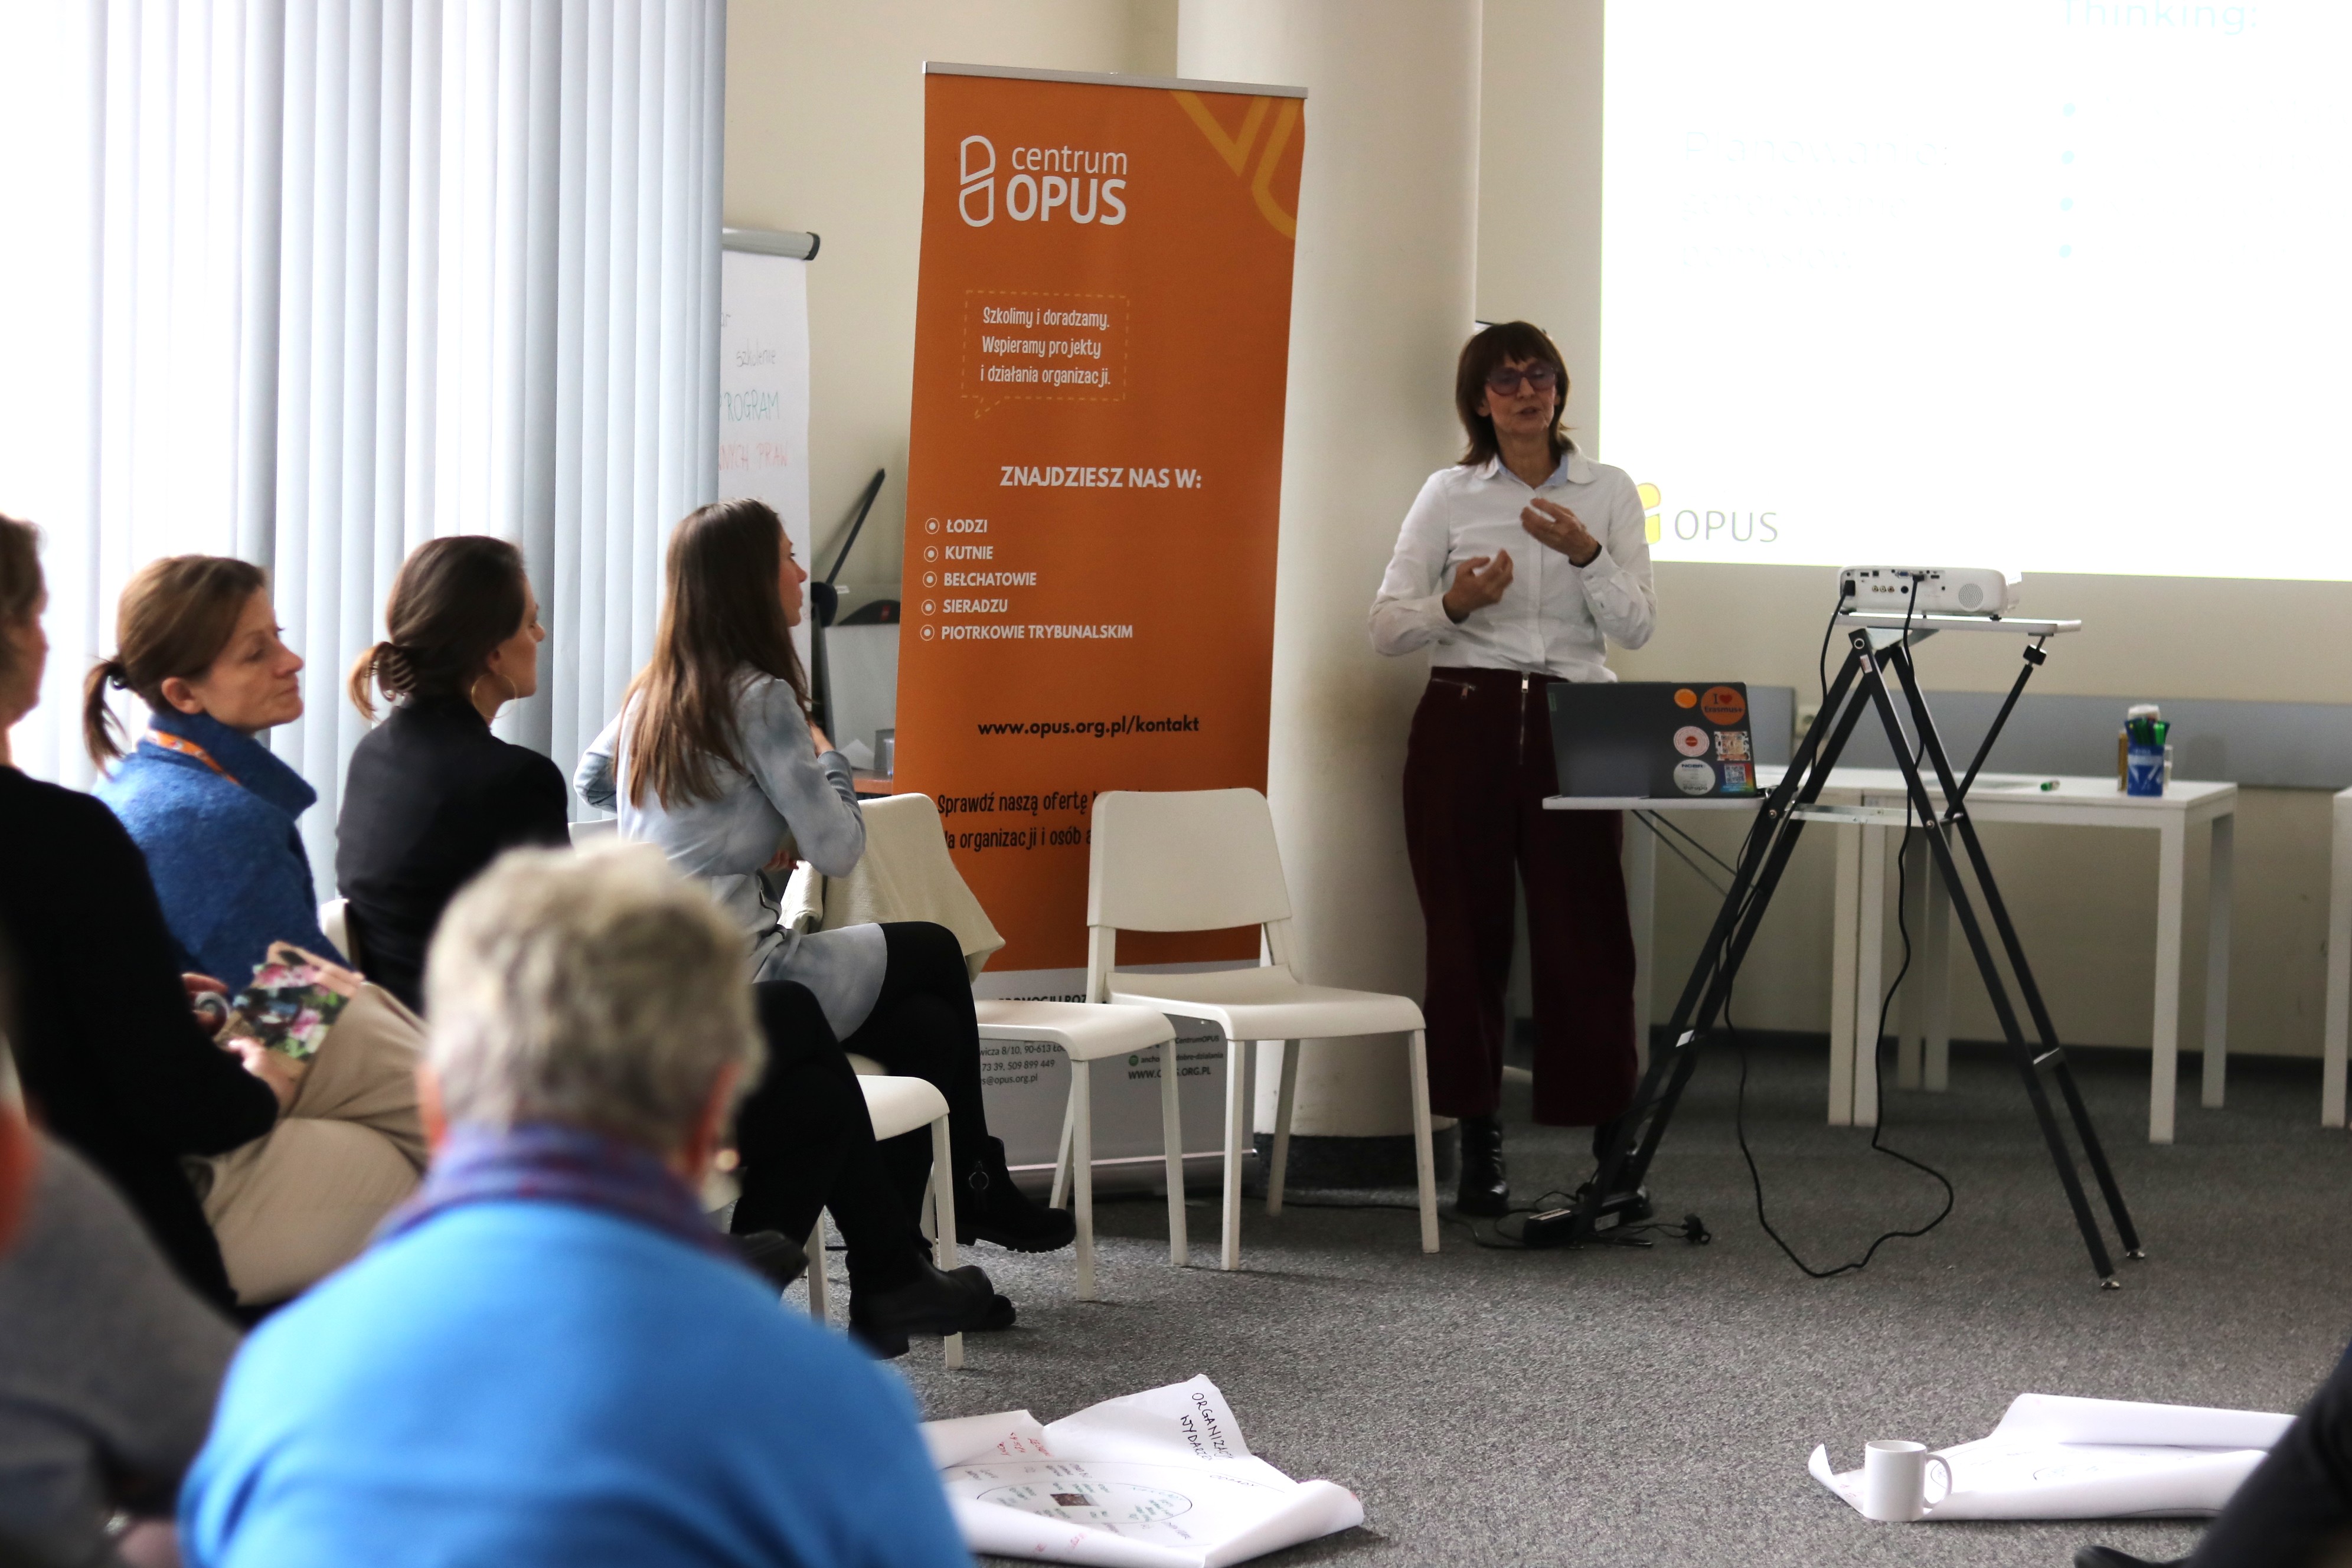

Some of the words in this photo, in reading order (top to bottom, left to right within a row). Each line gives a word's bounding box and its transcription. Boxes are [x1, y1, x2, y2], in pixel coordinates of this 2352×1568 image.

[1012, 145, 1127, 175] centrum
[1007, 174, 1126, 225] OPUS
[984, 307, 1033, 328] Szkolimy
[1037, 309, 1040, 325] i
[1044, 309, 1109, 331] doradzamy.
[982, 336, 1045, 357] Wspieramy
[1049, 338, 1101, 359] projekty
[981, 365, 984, 381] i
[988, 365, 1038, 382] działania
[1042, 367, 1110, 387] organizacji.
[1000, 466, 1123, 487] ZNAJDZIESZ
[1129, 468, 1170, 488] NAS
[1175, 469, 1201, 488] W:
[946, 520, 987, 533] ŁODZI
[1674, 509, 1779, 543] OPUS
[946, 546, 993, 559] KUTNIE
[944, 573, 1036, 586] BEŁCHATOWIE
[943, 599, 1007, 613] SIERADZU
[942, 625, 1024, 639] PIOTRKOWIE
[1028, 625, 1132, 638] TRYBUNALSKIM
[978, 714, 1199, 739] www.opus.org.pl/kontakt
[938, 792, 994, 817] Sprawdź
[999, 796, 1038, 816] naszą
[1043, 792, 1087, 815] ofertę
[960, 827, 1037, 852] organizacji
[1041, 827, 1045, 845] i
[1050, 827, 1082, 845] osób
[1024, 1044, 1051, 1053] 90-613
[982, 1063, 991, 1072] 73
[1008, 1061, 1022, 1070] 509
[1024, 1061, 1038, 1069] 899
[1040, 1060, 1055, 1068] 449
[981, 1073, 1037, 1086] s@opus.org.pl
